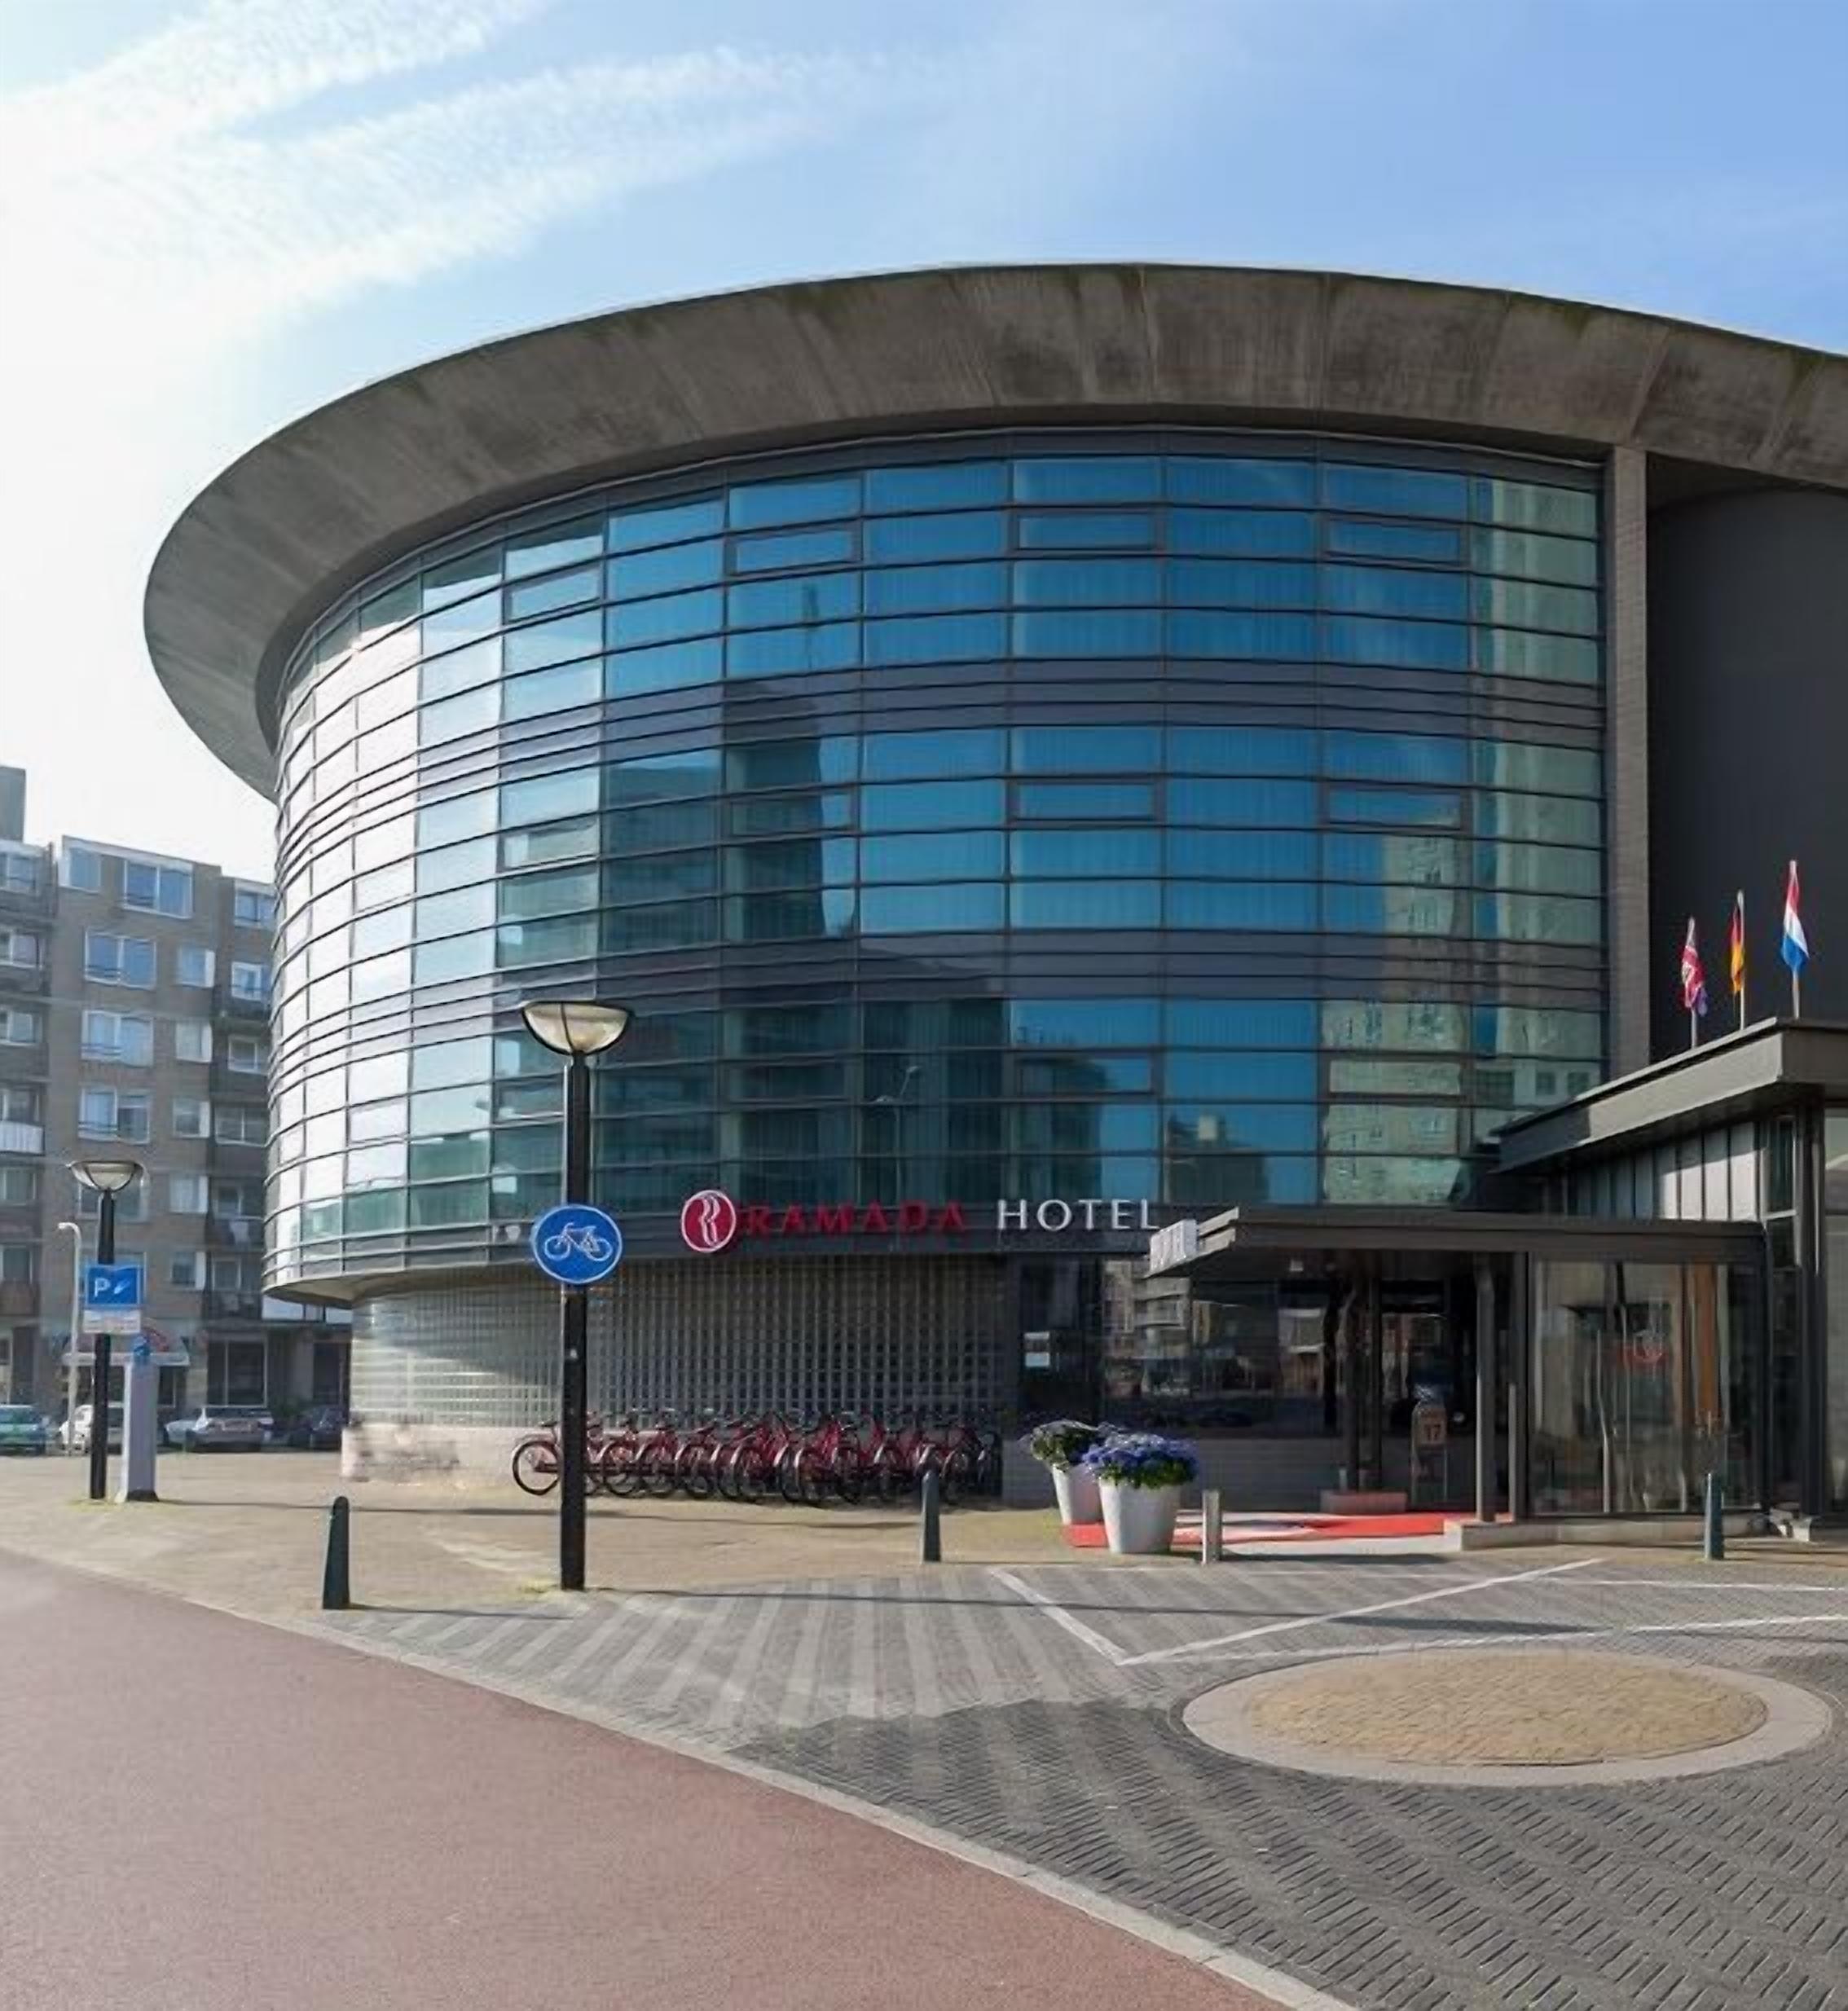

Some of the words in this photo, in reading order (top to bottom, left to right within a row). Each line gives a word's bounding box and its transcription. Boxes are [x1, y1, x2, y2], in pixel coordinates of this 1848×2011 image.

[747, 1201, 966, 1234] RAMADA
[997, 1199, 1160, 1232] HOTEL
[94, 1277, 112, 1298] P
